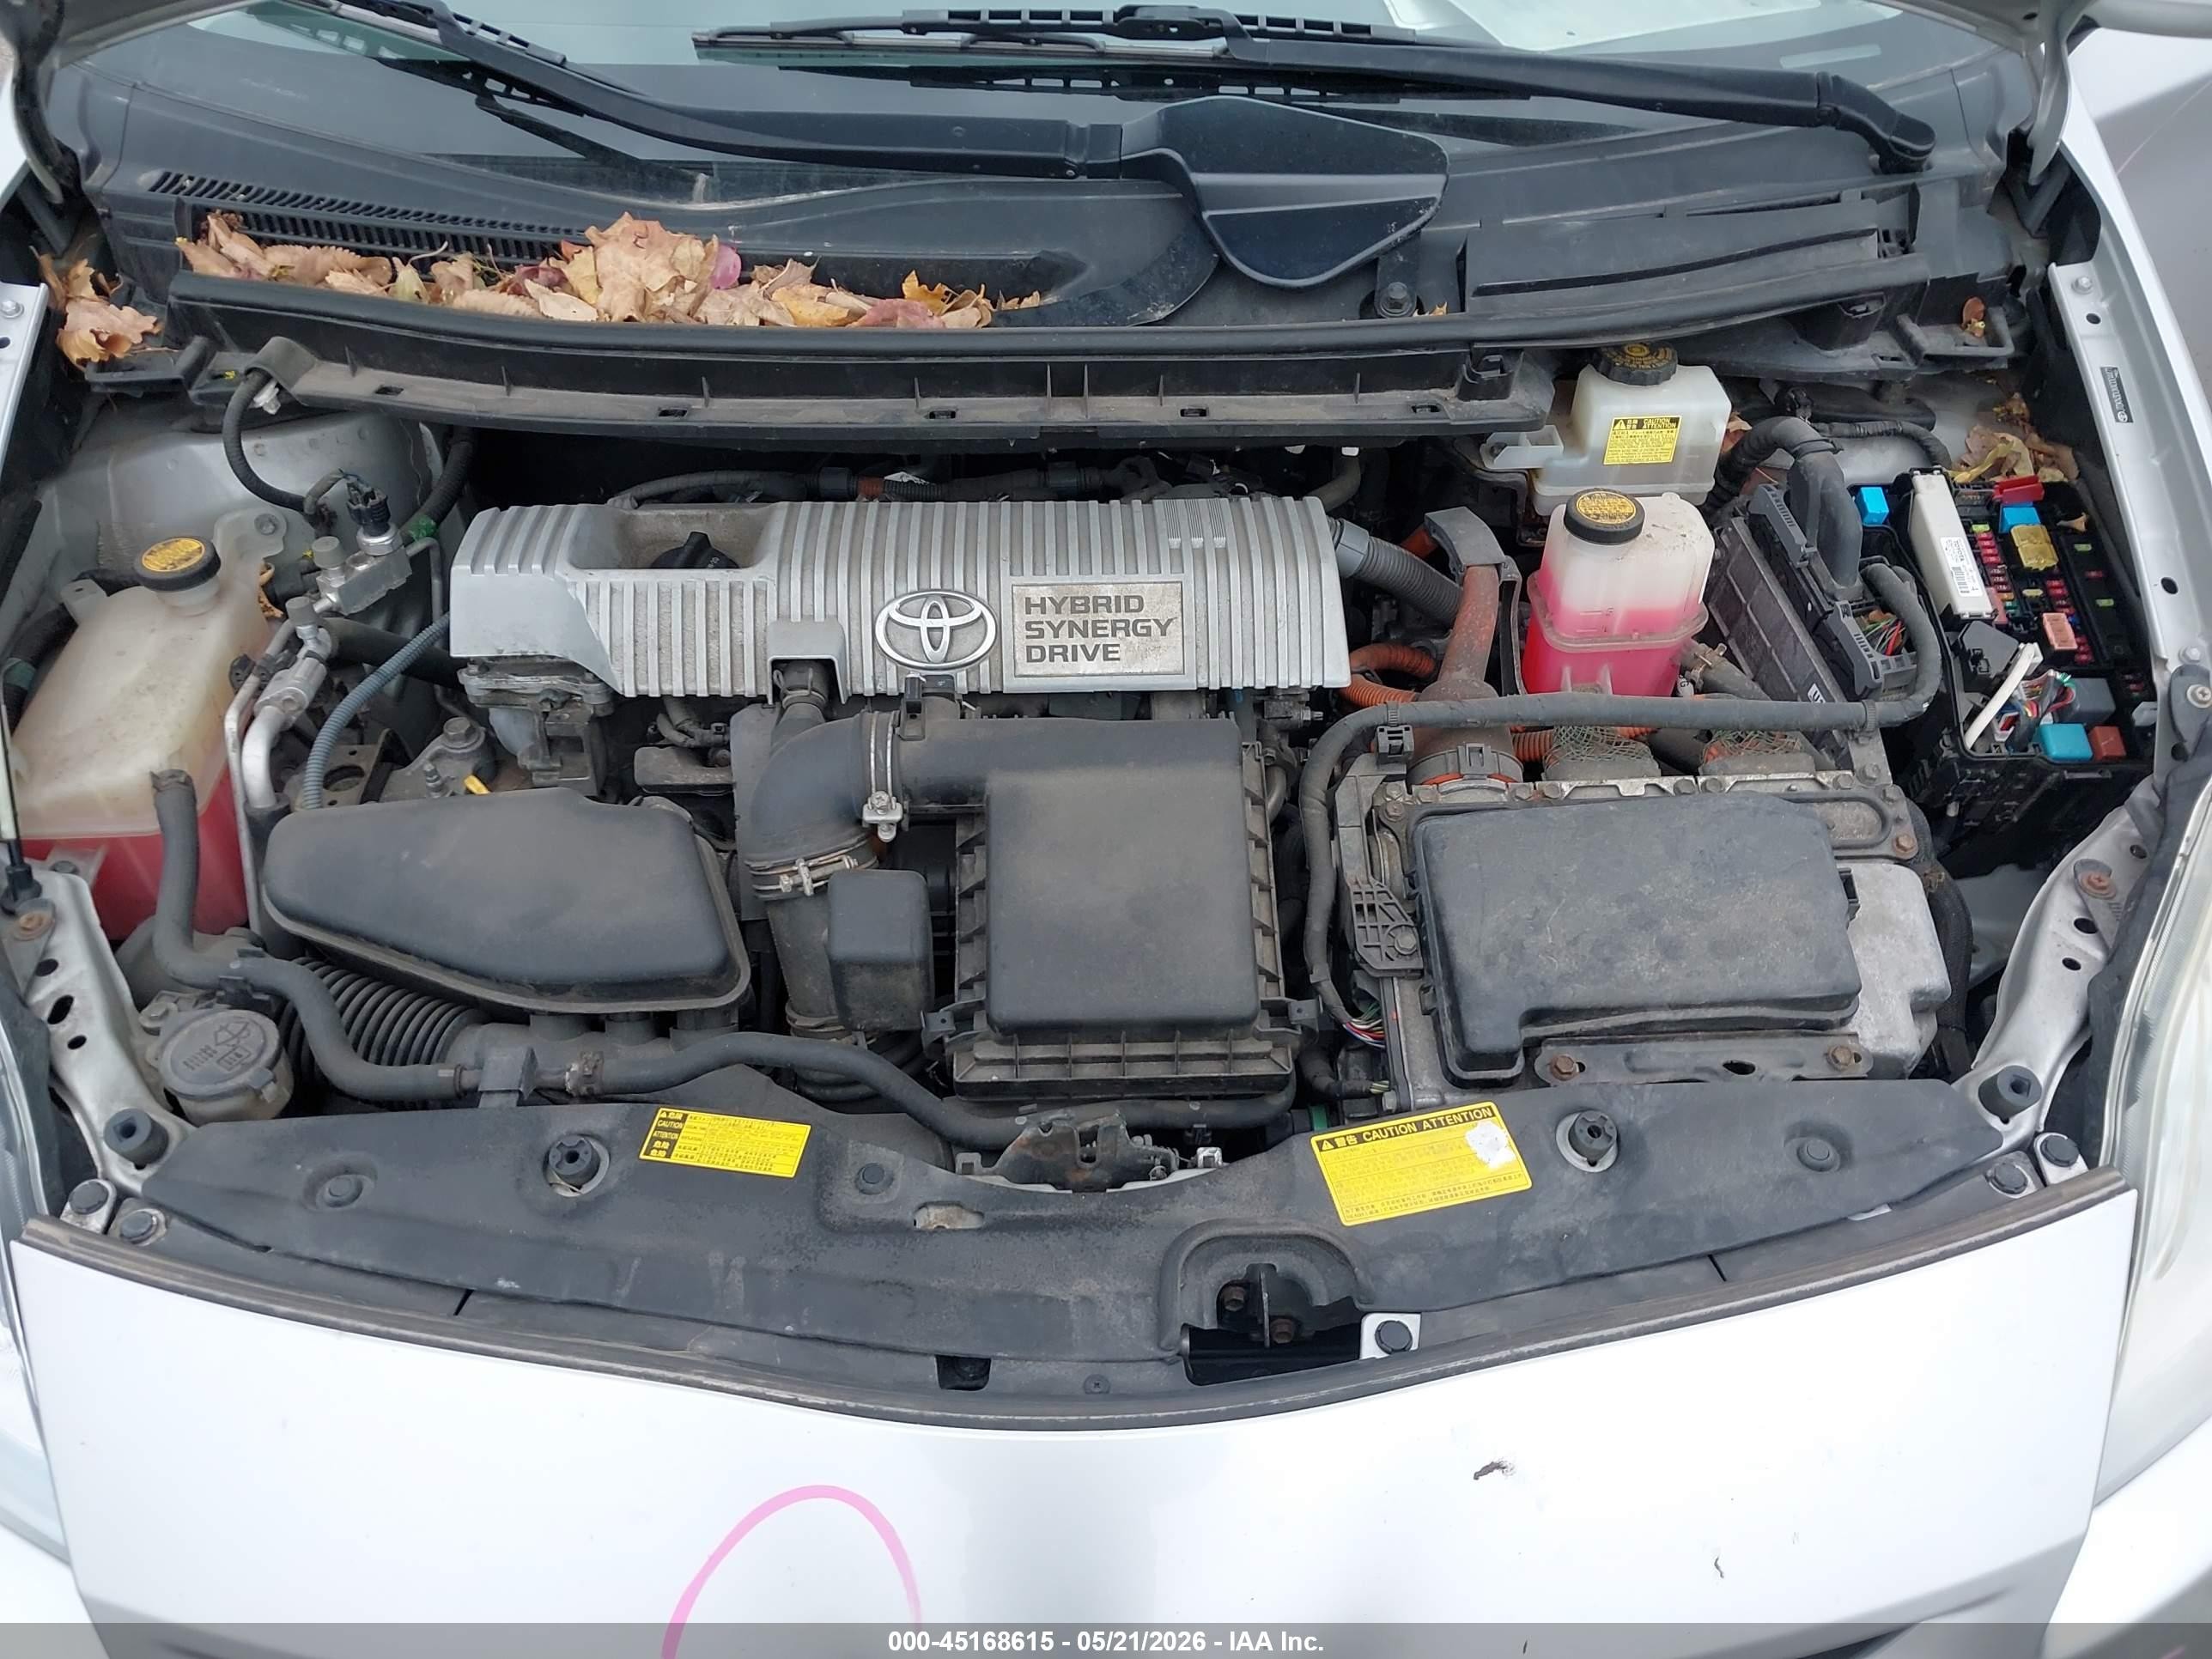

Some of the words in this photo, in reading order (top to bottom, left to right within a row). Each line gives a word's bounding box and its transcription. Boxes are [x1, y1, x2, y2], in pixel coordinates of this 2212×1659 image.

[1025, 595, 1145, 615] HYBRID
[1025, 618, 1175, 639] SYNERGY
[1026, 643, 1121, 663] DRIVE
[657, 1120, 684, 1129] CAUTION
[1362, 1122, 1417, 1142] CAUTION
[1422, 1107, 1493, 1131] ATTENTION
